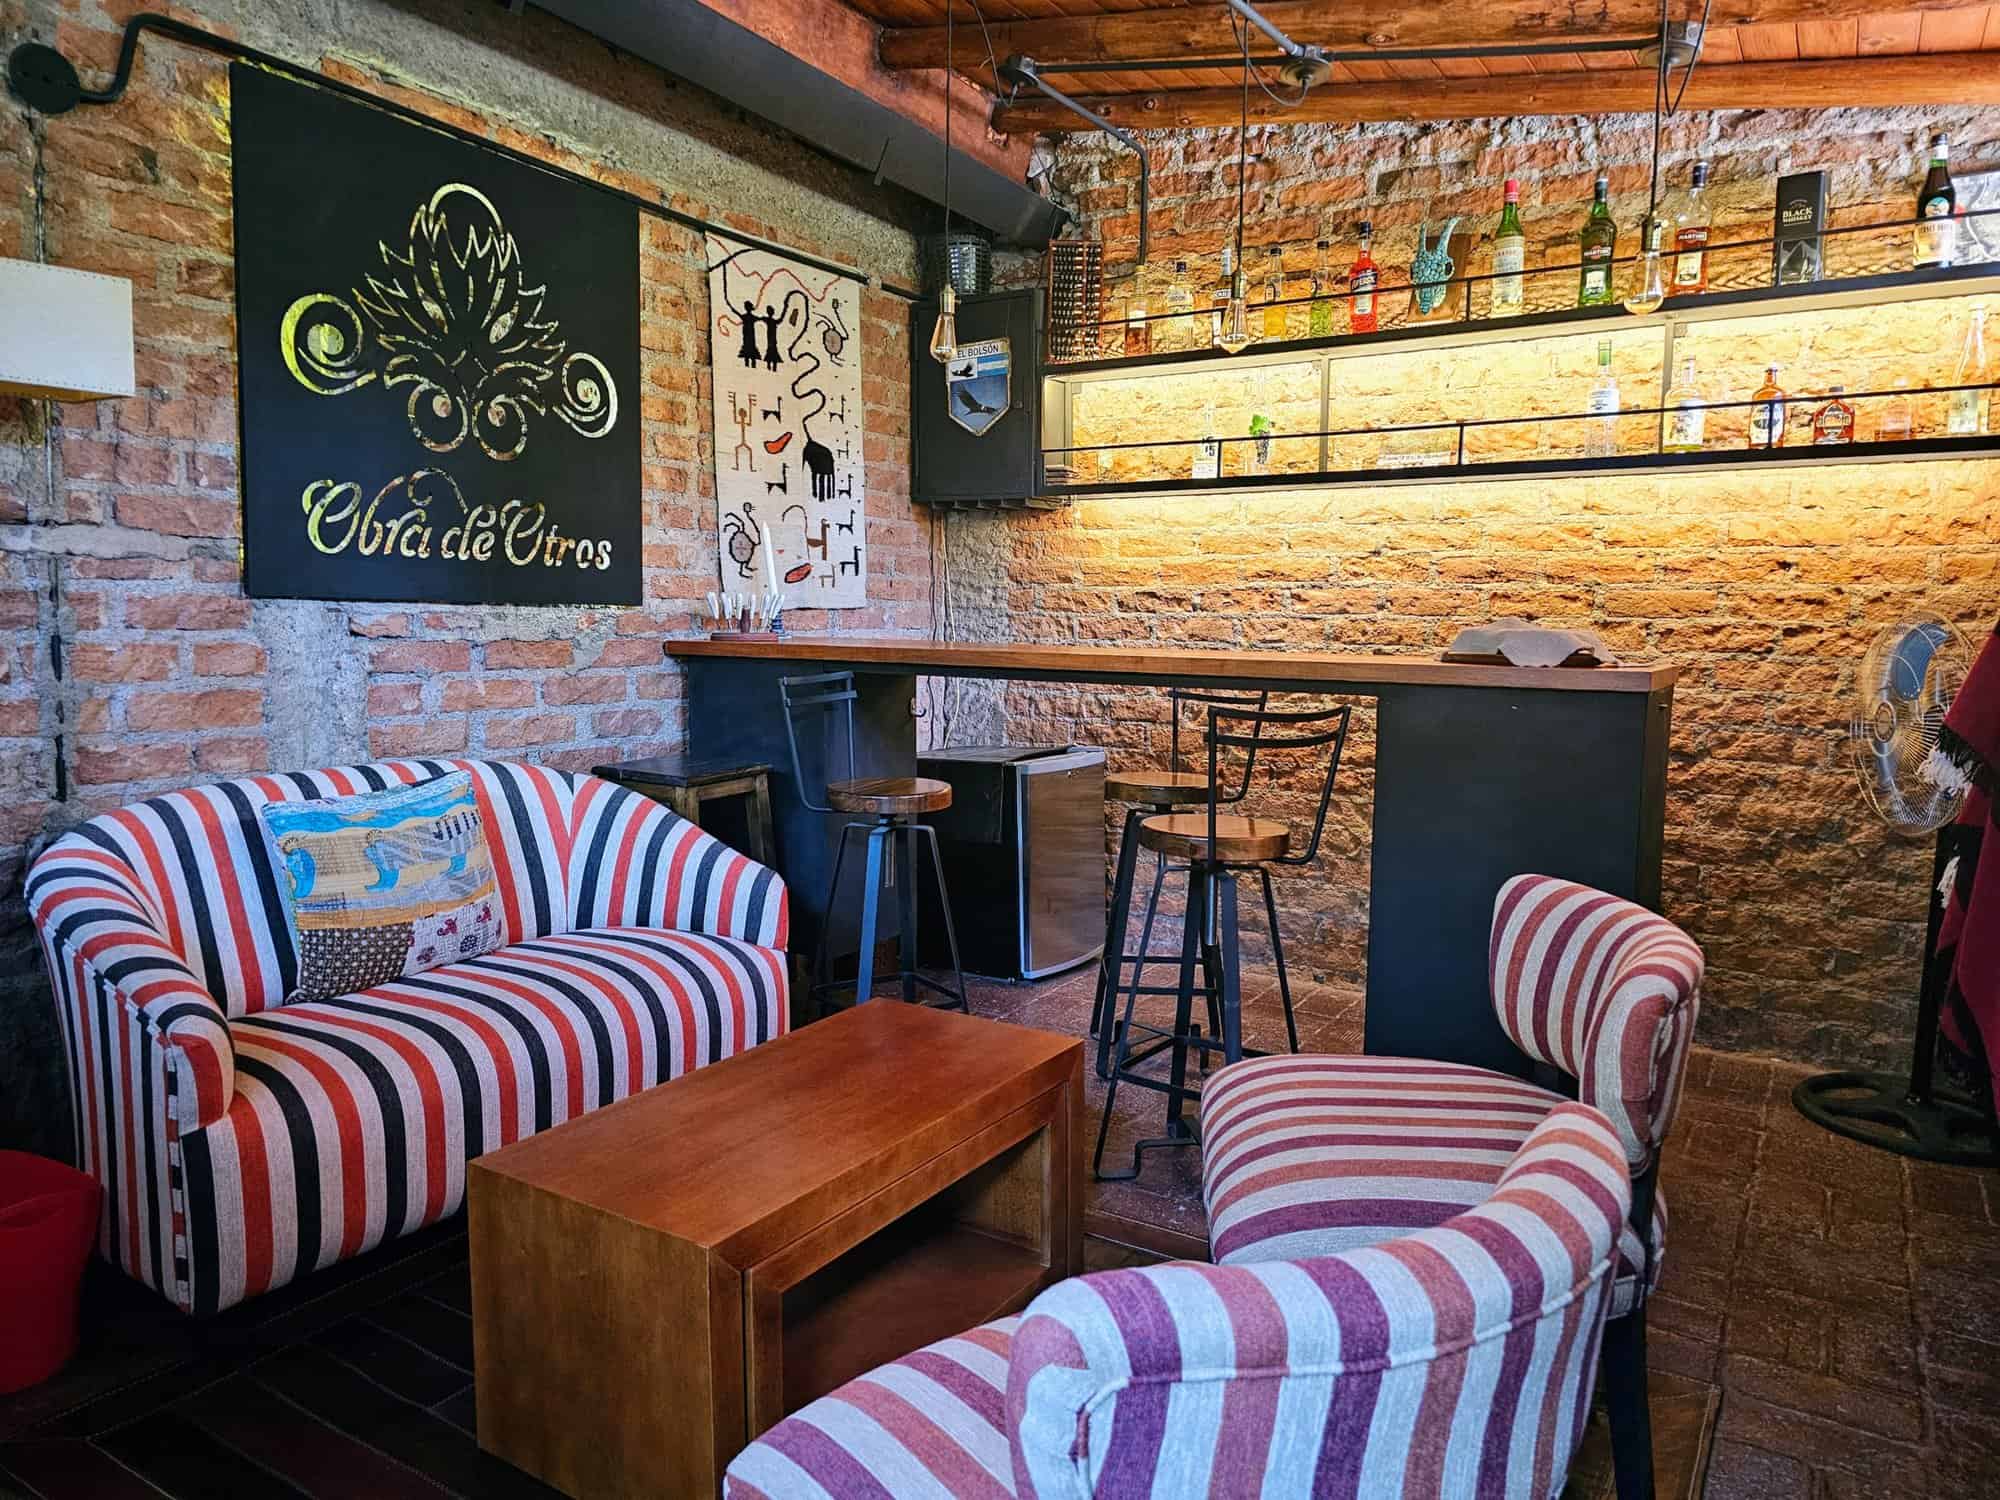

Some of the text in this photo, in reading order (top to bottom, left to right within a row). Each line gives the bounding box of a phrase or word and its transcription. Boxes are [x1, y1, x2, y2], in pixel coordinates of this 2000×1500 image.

[1782, 207, 1813, 218] BLACK
[957, 343, 999, 358] EL BOLSÓN
[301, 478, 433, 560] Obra
